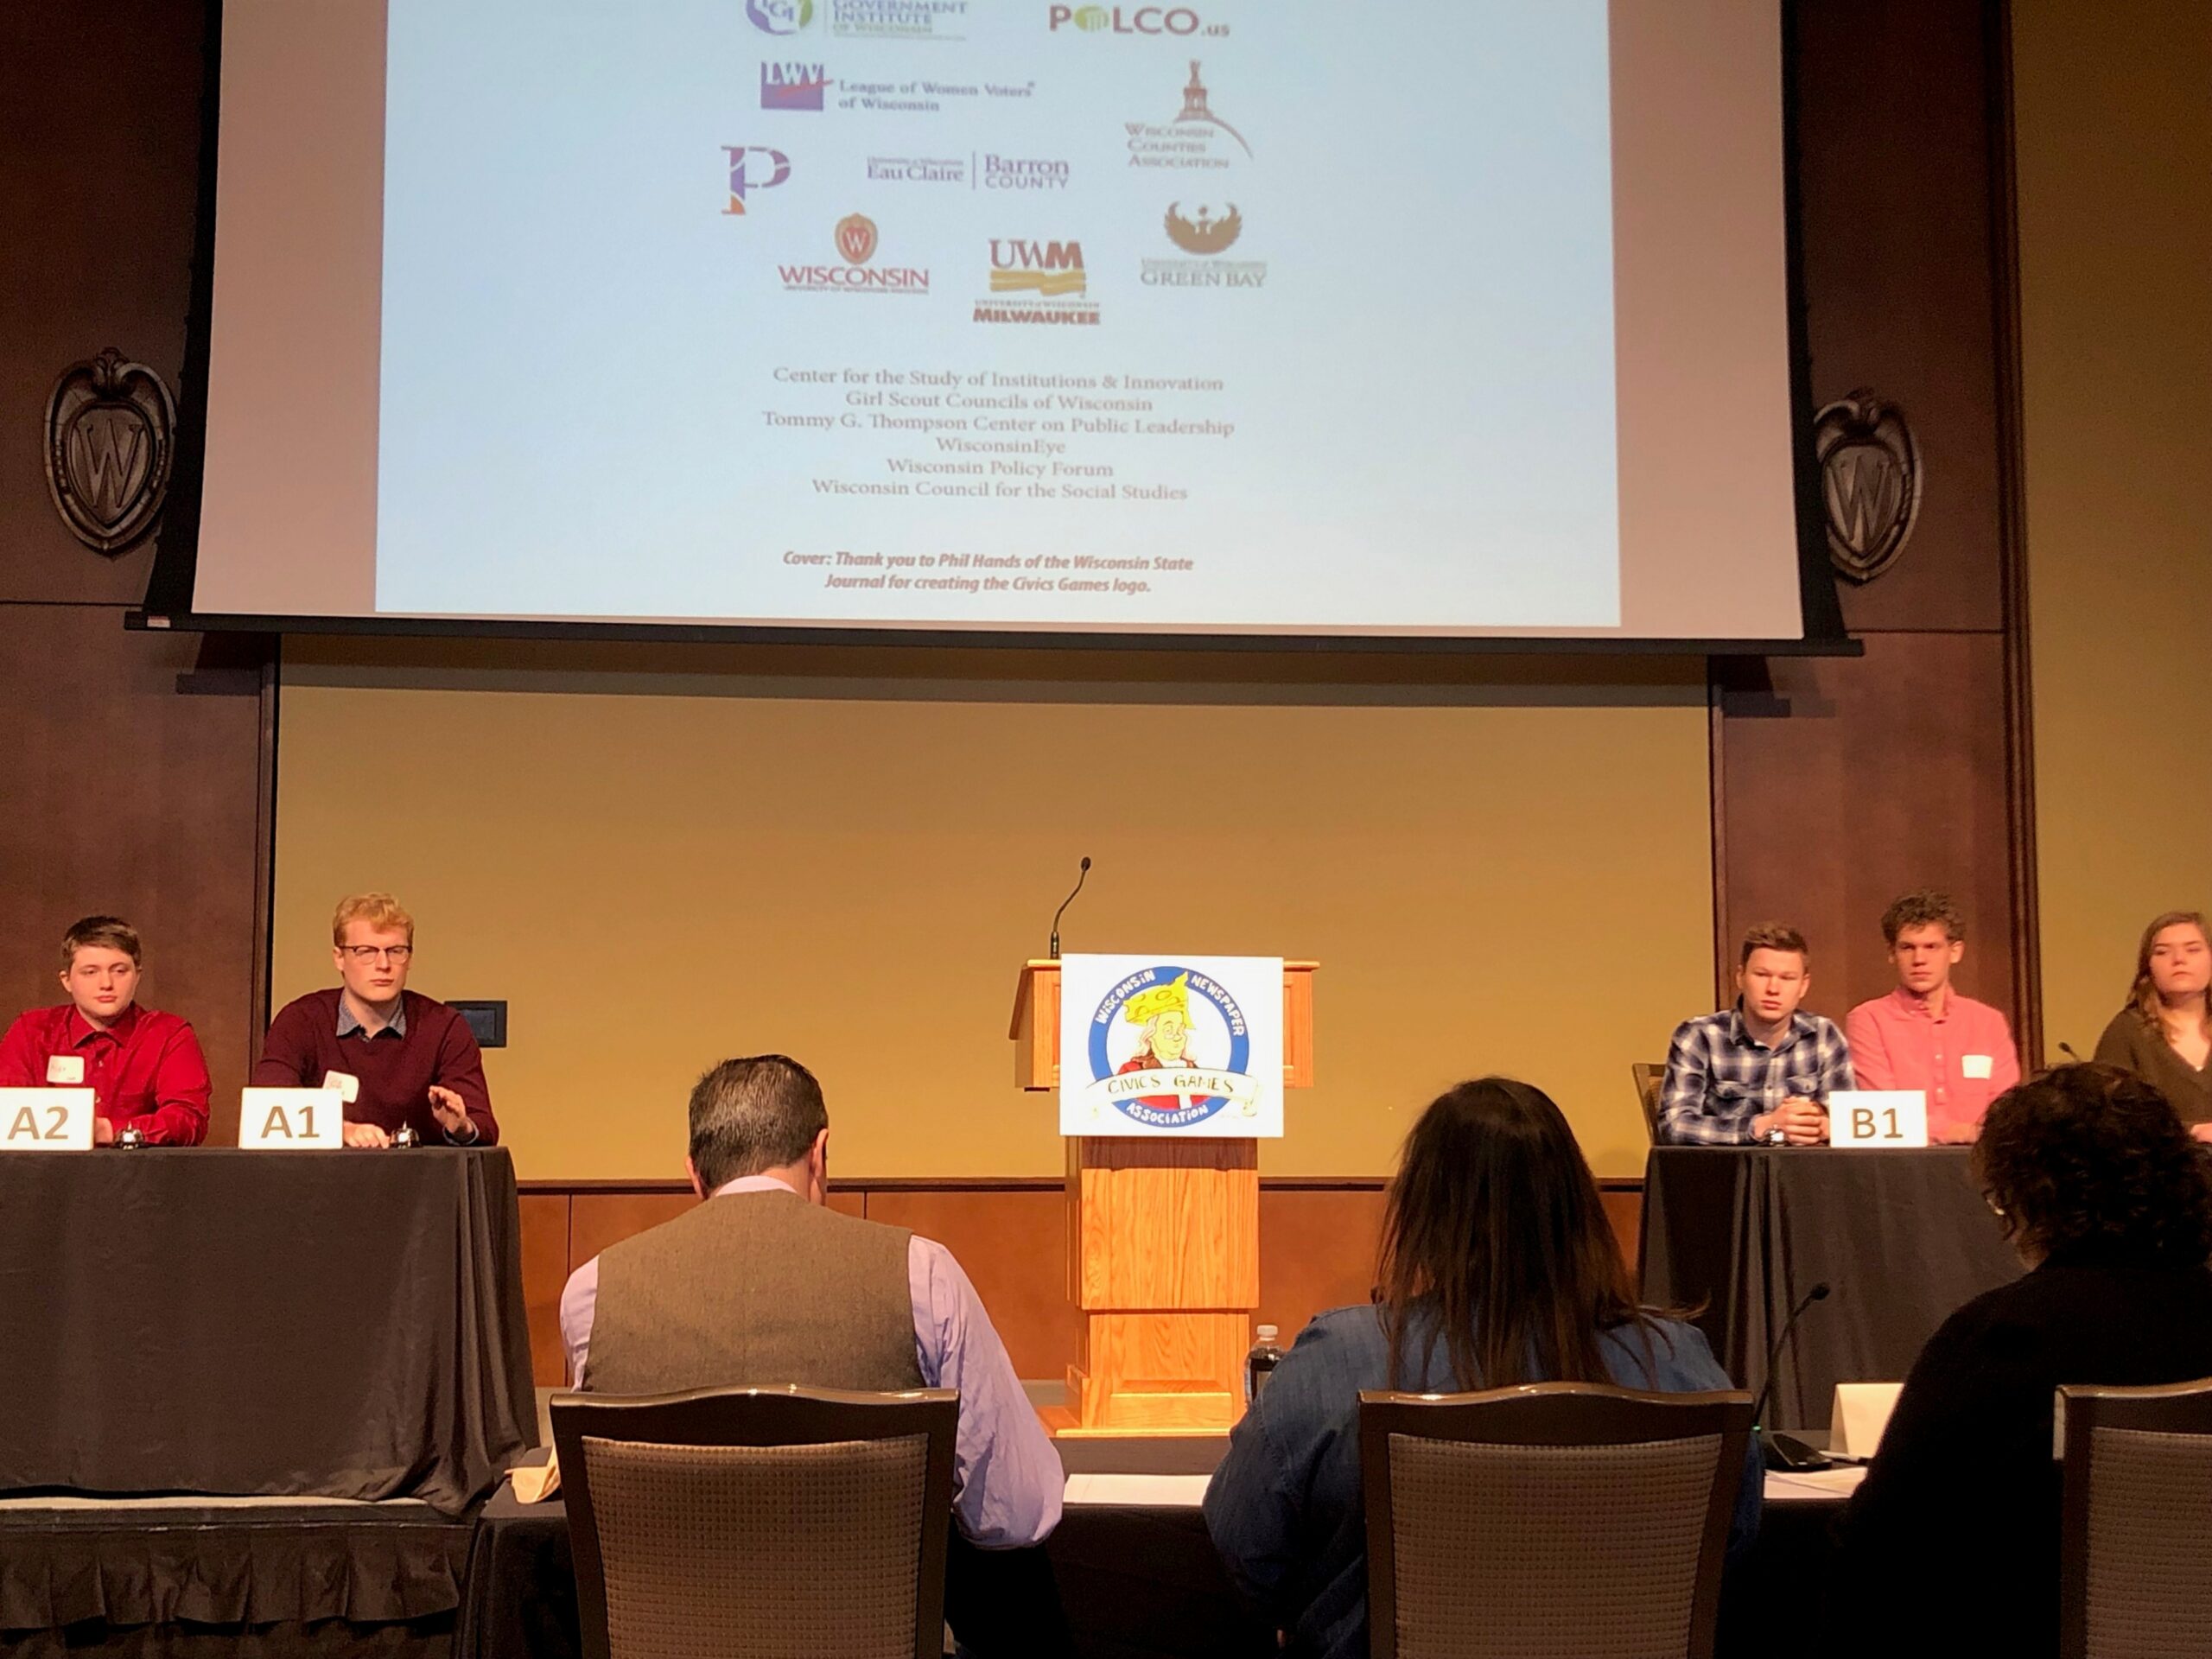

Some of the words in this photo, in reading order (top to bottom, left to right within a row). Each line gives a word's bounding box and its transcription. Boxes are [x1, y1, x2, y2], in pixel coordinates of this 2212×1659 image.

[834, 10, 932, 24] INSTITUTE
[840, 79, 894, 95] League
[899, 81, 918, 94] of
[922, 82, 978, 96] Women
[838, 97, 857, 109] of
[861, 98, 940, 111] Wisconsin
[868, 163, 902, 180] Eau
[906, 165, 963, 181] Claire
[985, 154, 1069, 175] Barron
[986, 175, 1068, 189] COUNTY
[988, 238, 1084, 269] UWM
[778, 264, 929, 287] WISCONSIN
[1141, 269, 1220, 286] GREEN
[1226, 272, 1266, 287] BAY
[973, 308, 1100, 325] MILWAUKEE
[773, 366, 836, 384] Center
[843, 368, 870, 384] for
[875, 369, 905, 385] the
[909, 371, 962, 390] Study
[967, 372, 987, 387] of
[992, 372, 1096, 389] Institutions
[1103, 375, 1118, 389] &
[1123, 374, 1224, 391] Innovation
[846, 391, 883, 406] Girl
[888, 392, 940, 407] Scout
[946, 392, 1027, 409] Councils
[1033, 394, 1053, 410] of
[1058, 395, 1153, 411] Wisconsin
[762, 410, 835, 430] Tommy
[840, 412, 862, 429] G.
[867, 413, 967, 433] Thompson
[974, 416, 1035, 432] Center
[1041, 421, 1065, 432] on
[1071, 417, 1129, 434] Public
[1135, 418, 1235, 438] Leadership
[936, 436, 1066, 457] WisconsinEye
[887, 458, 984, 474] Wisconsin
[990, 461, 1046, 479] Policy
[1052, 461, 1114, 477] Forum
[812, 479, 910, 495] Wisconsin
[915, 480, 989, 497] Council
[995, 482, 1022, 498] for
[1027, 483, 1056, 499] the
[1061, 484, 1116, 499] Social
[1122, 484, 1188, 500] Studies
[783, 550, 832, 565] Cover:
[836, 551, 884, 566] Thank
[886, 555, 915, 570] you
[918, 555, 935, 567] to
[938, 553, 970, 568] Phil
[972, 554, 1021, 569] Hands
[1025, 555, 1044, 569] of
[1044, 556, 1070, 569] the
[1074, 556, 1150, 570] Wisconsin
[1154, 556, 1193, 571] State
[824, 574, 886, 589] Journal
[887, 575, 912, 589] for
[914, 576, 980, 594] creating
[983, 576, 1009, 590] the
[1013, 576, 1054, 591] Civics
[1058, 577, 1110, 592] Games
[1112, 577, 1152, 595] logo.
[1191, 974, 1244, 1037] NEWSPAPER
[1108, 1076, 1161, 1095] CIVICS
[1174, 1074, 1234, 1093] GAMES
[7, 1106, 69, 1140] A2
[260, 1105, 321, 1139] A1
[1851, 1108, 1904, 1139] B1
